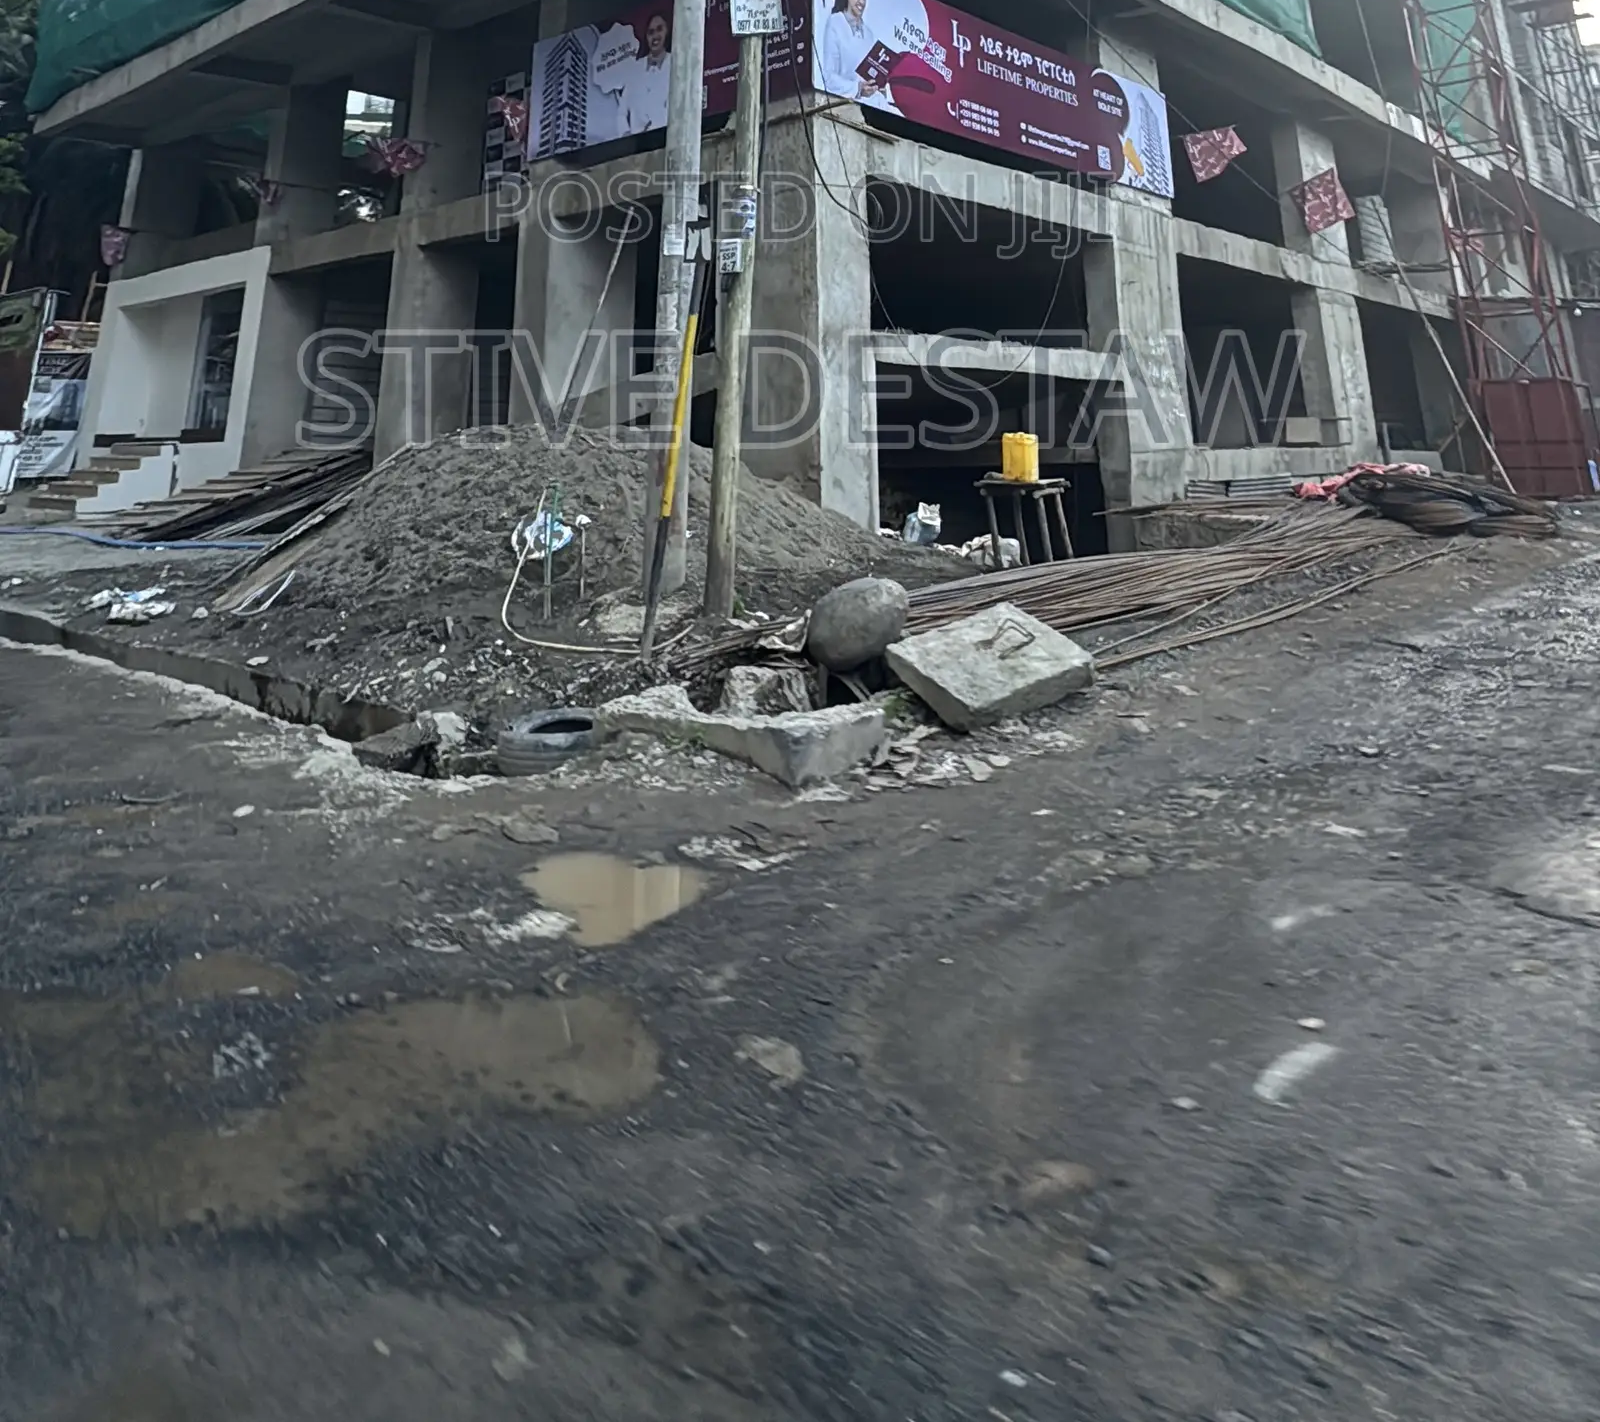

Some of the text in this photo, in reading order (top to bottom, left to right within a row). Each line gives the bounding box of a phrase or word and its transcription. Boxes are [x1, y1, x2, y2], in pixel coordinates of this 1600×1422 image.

[894, 25, 952, 83] We are selling
[977, 58, 1079, 107] LIFETIME PROPERTIES
